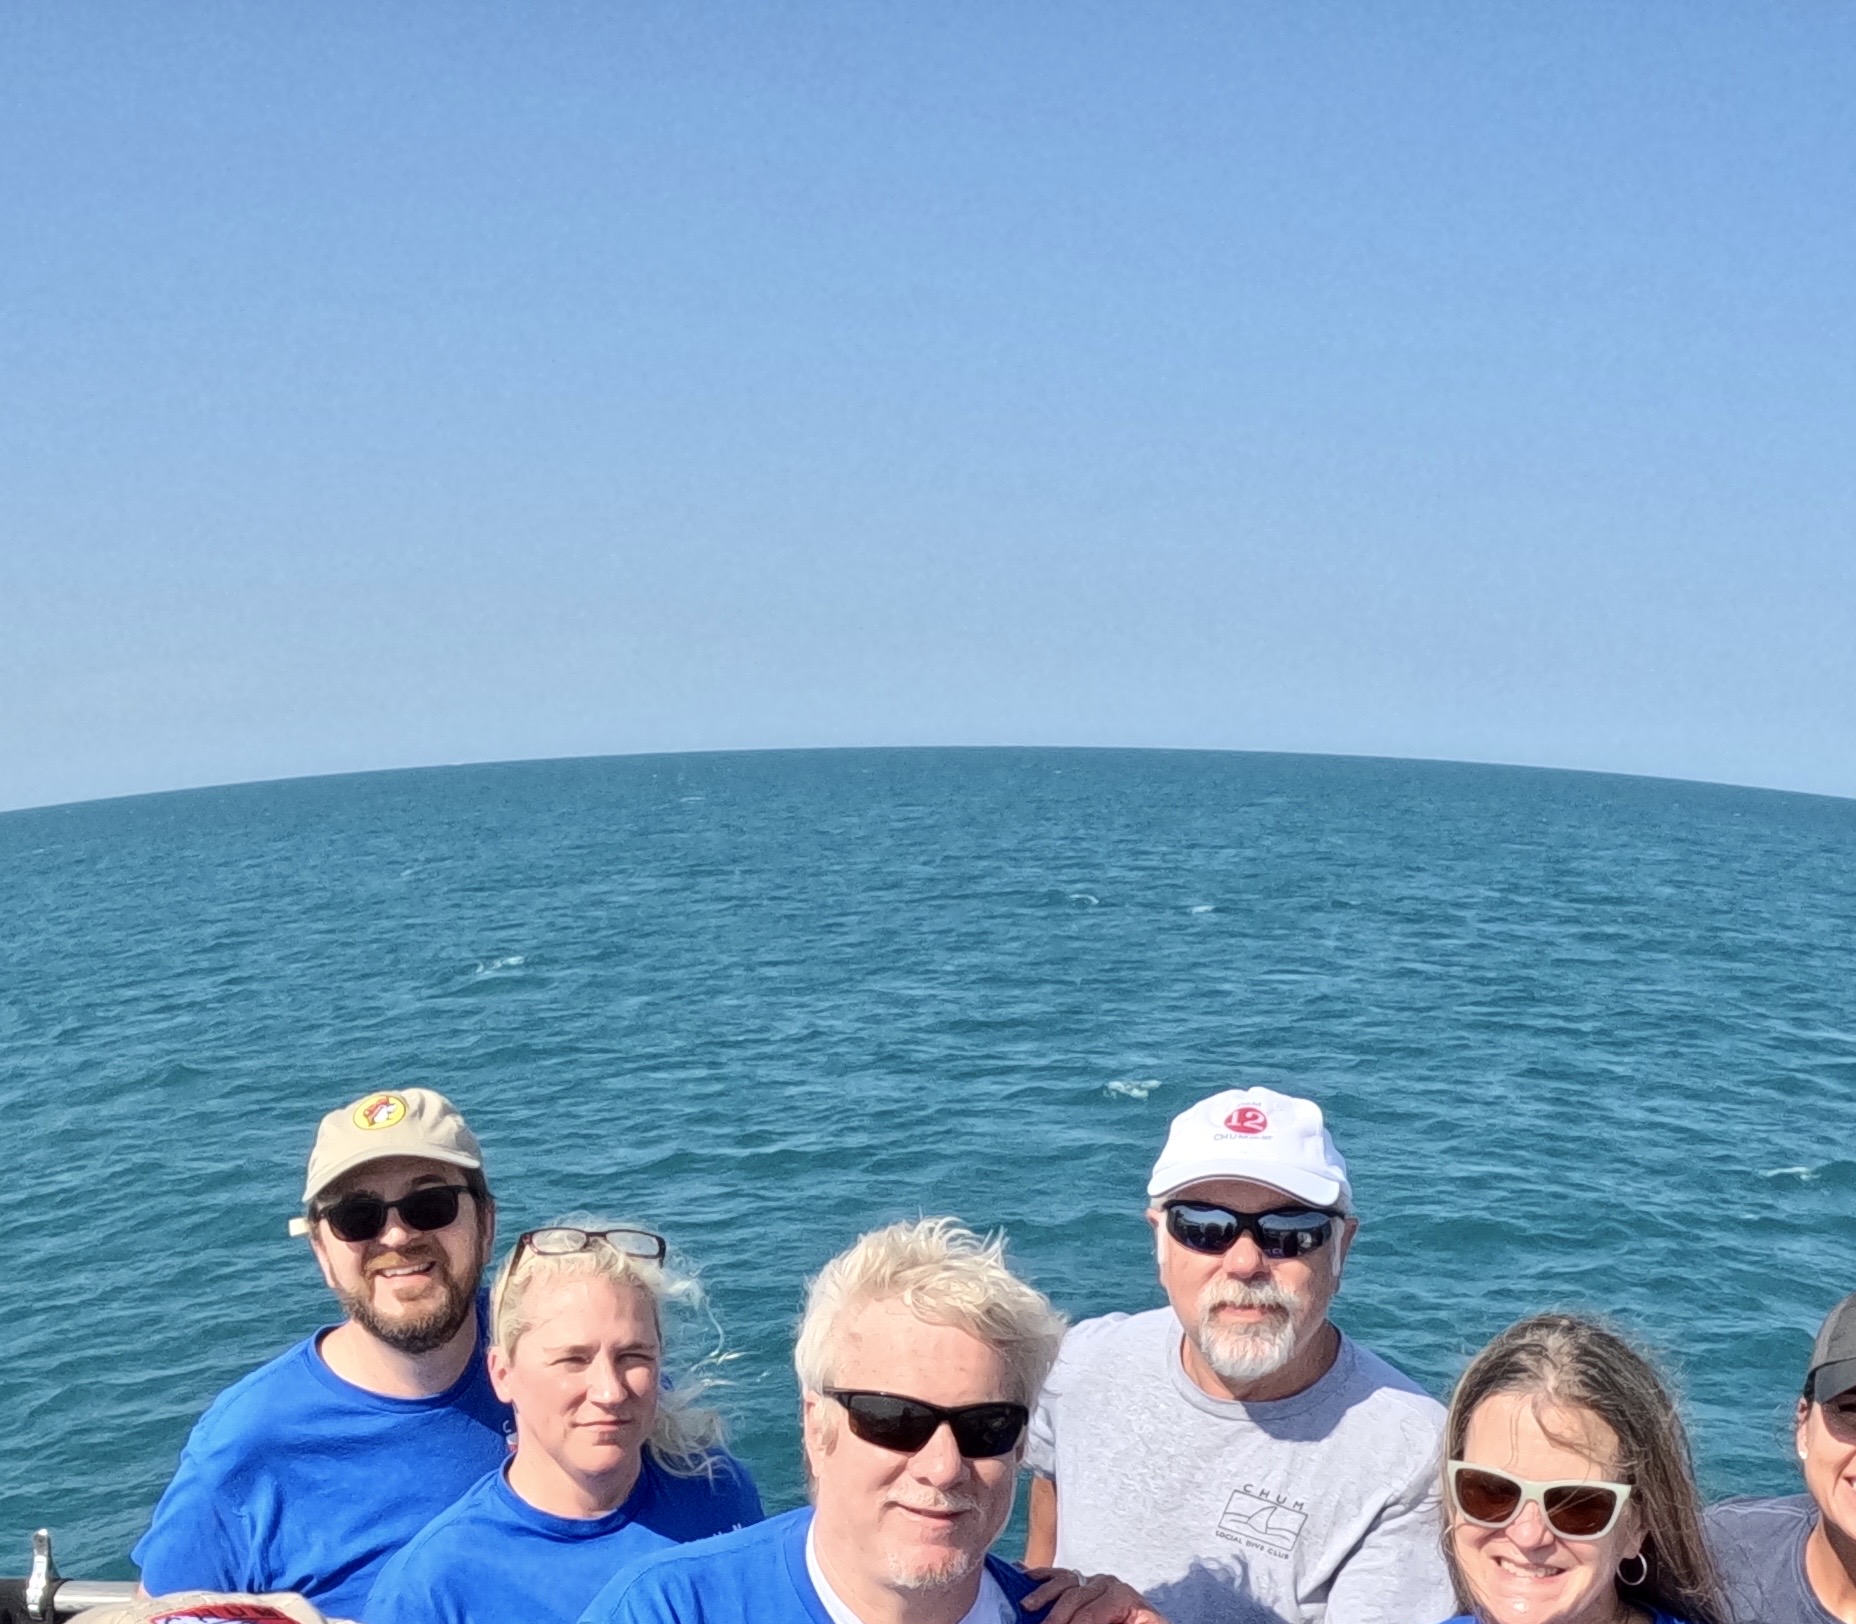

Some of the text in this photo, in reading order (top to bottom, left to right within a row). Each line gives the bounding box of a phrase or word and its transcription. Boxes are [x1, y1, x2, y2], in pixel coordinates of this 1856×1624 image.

[1226, 1110, 1265, 1131] 12
[1243, 1483, 1304, 1511] CHUM
[1215, 1530, 1289, 1559] SOCIAL DIVE CLUB
